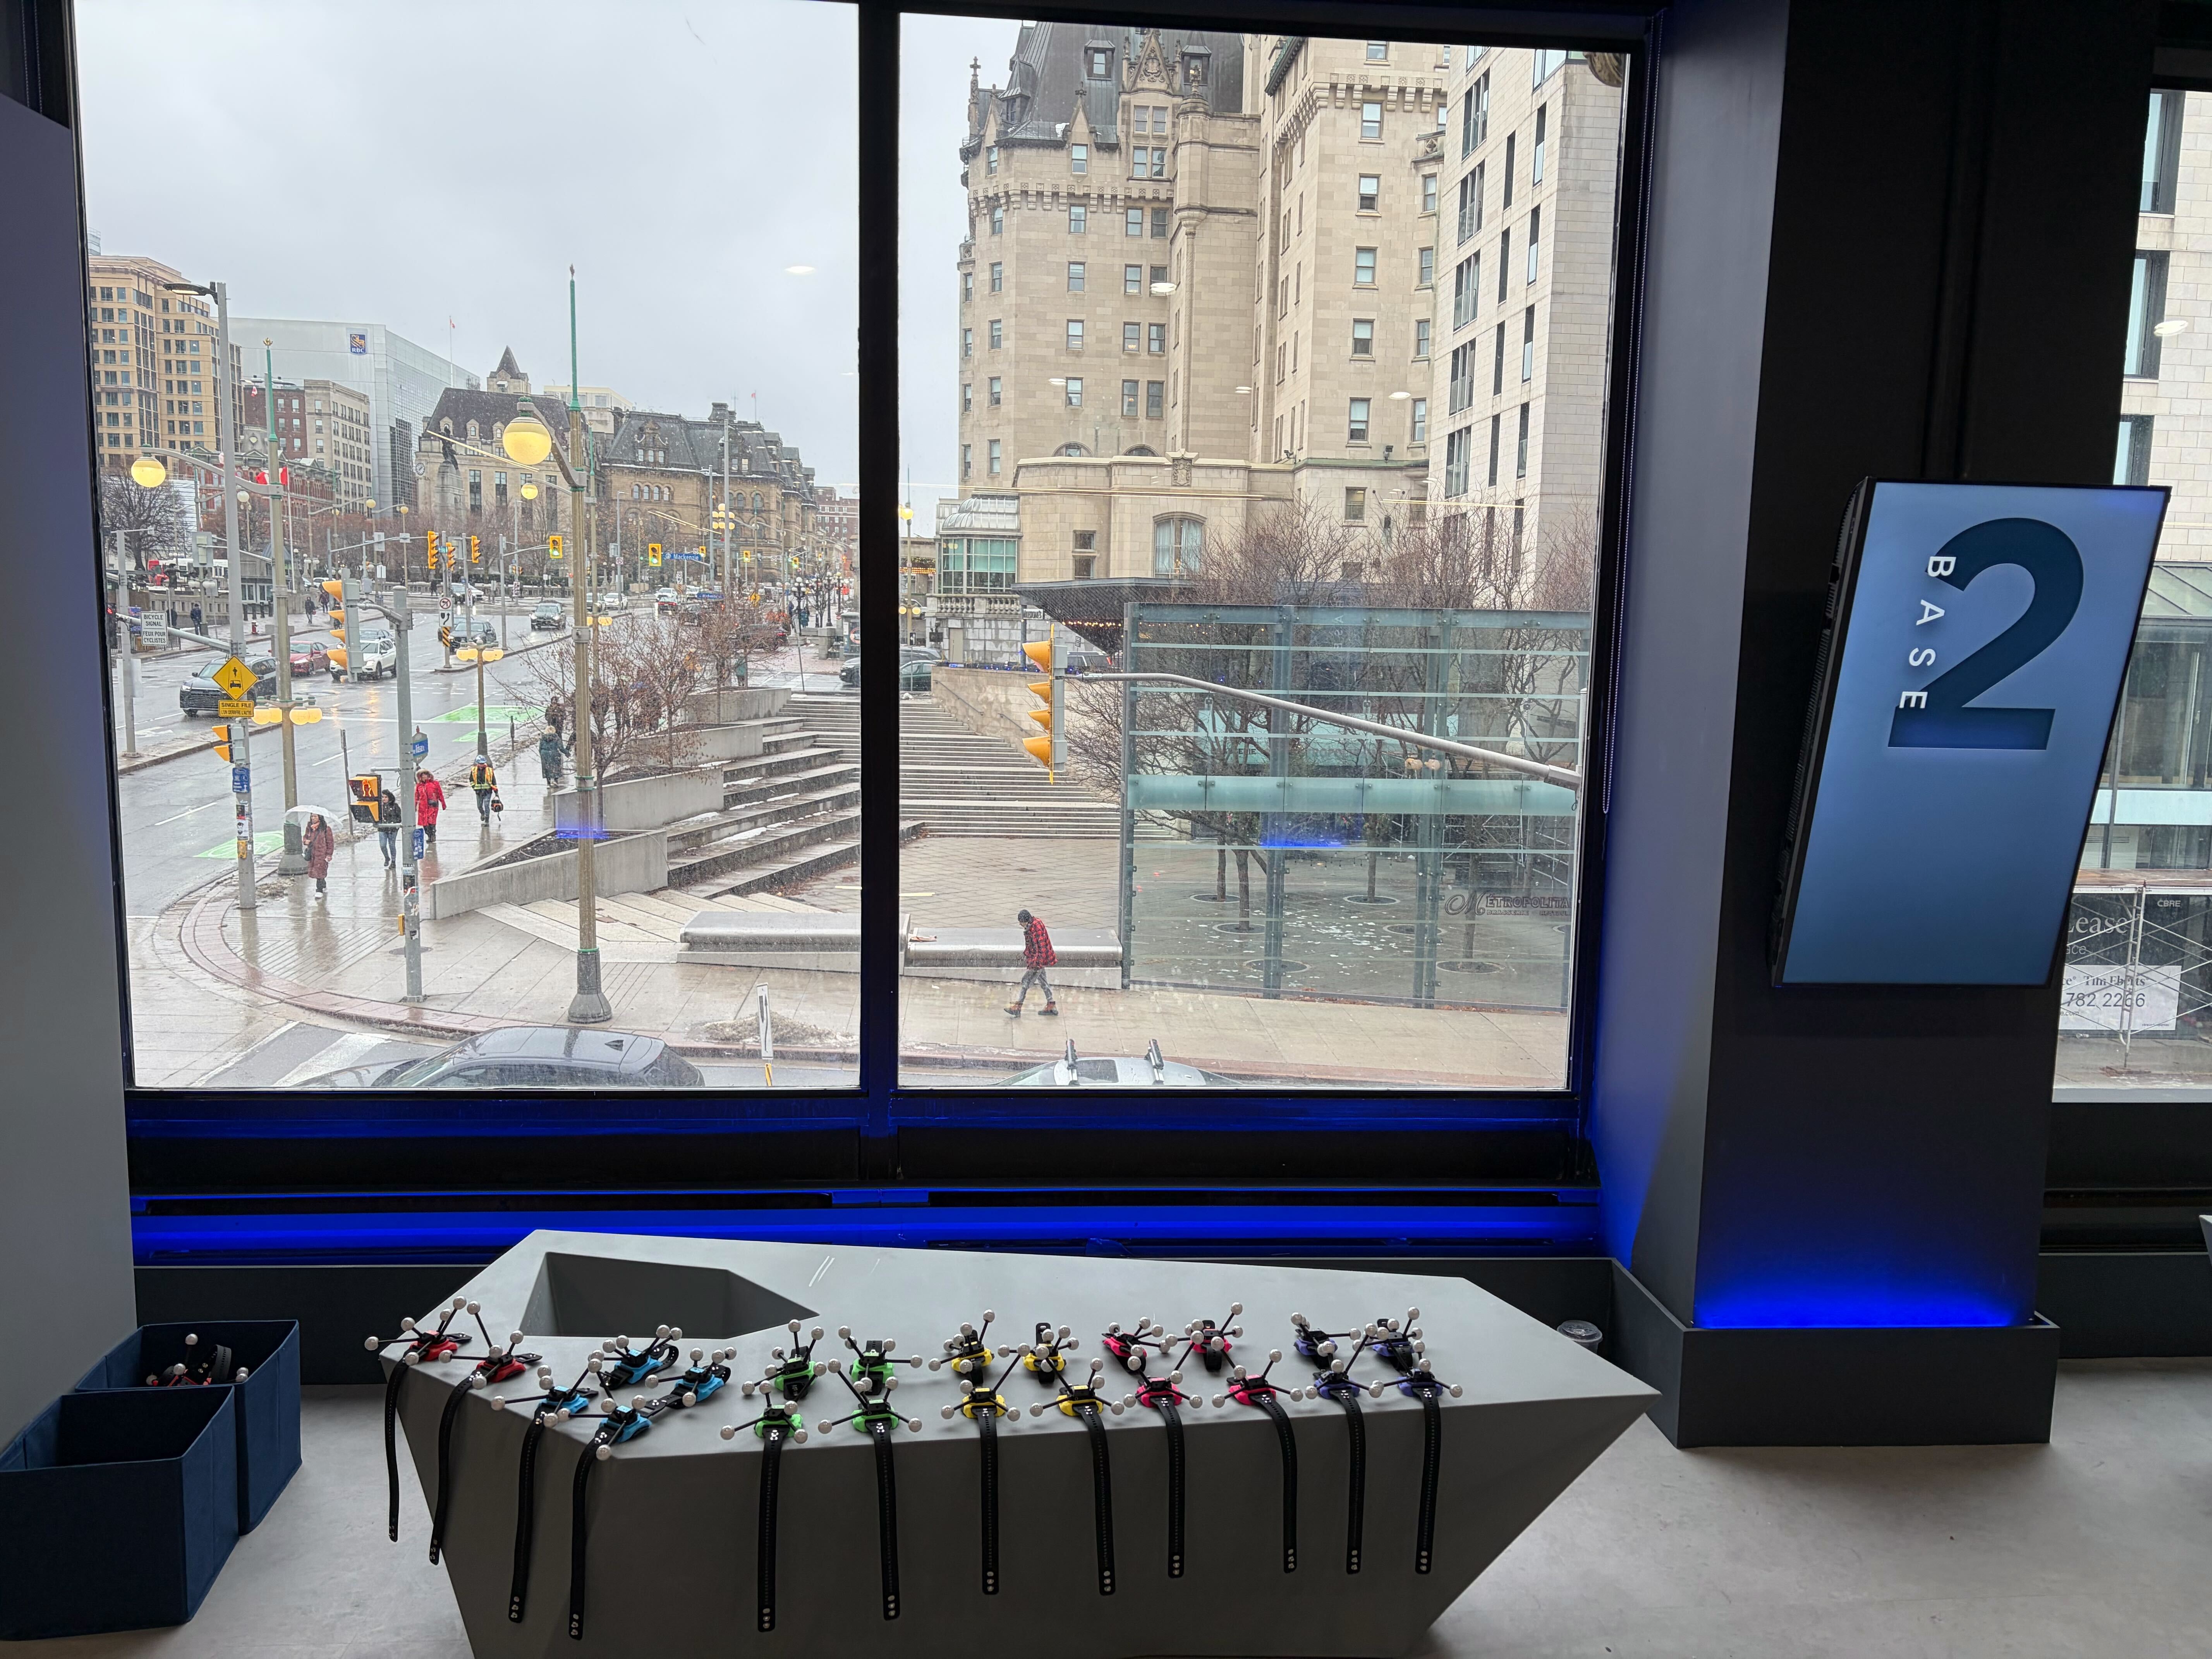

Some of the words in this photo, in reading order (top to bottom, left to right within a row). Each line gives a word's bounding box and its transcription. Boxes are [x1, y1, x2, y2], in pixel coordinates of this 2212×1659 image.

[1887, 517, 2084, 750] 2
[1899, 556, 1957, 709] BASE
[1445, 890, 1571, 915] MÉTROPOLITA
[2083, 975, 2106, 986] Tim
[2066, 993, 2096, 1007] 782
[2102, 993, 2146, 1007] 2266
